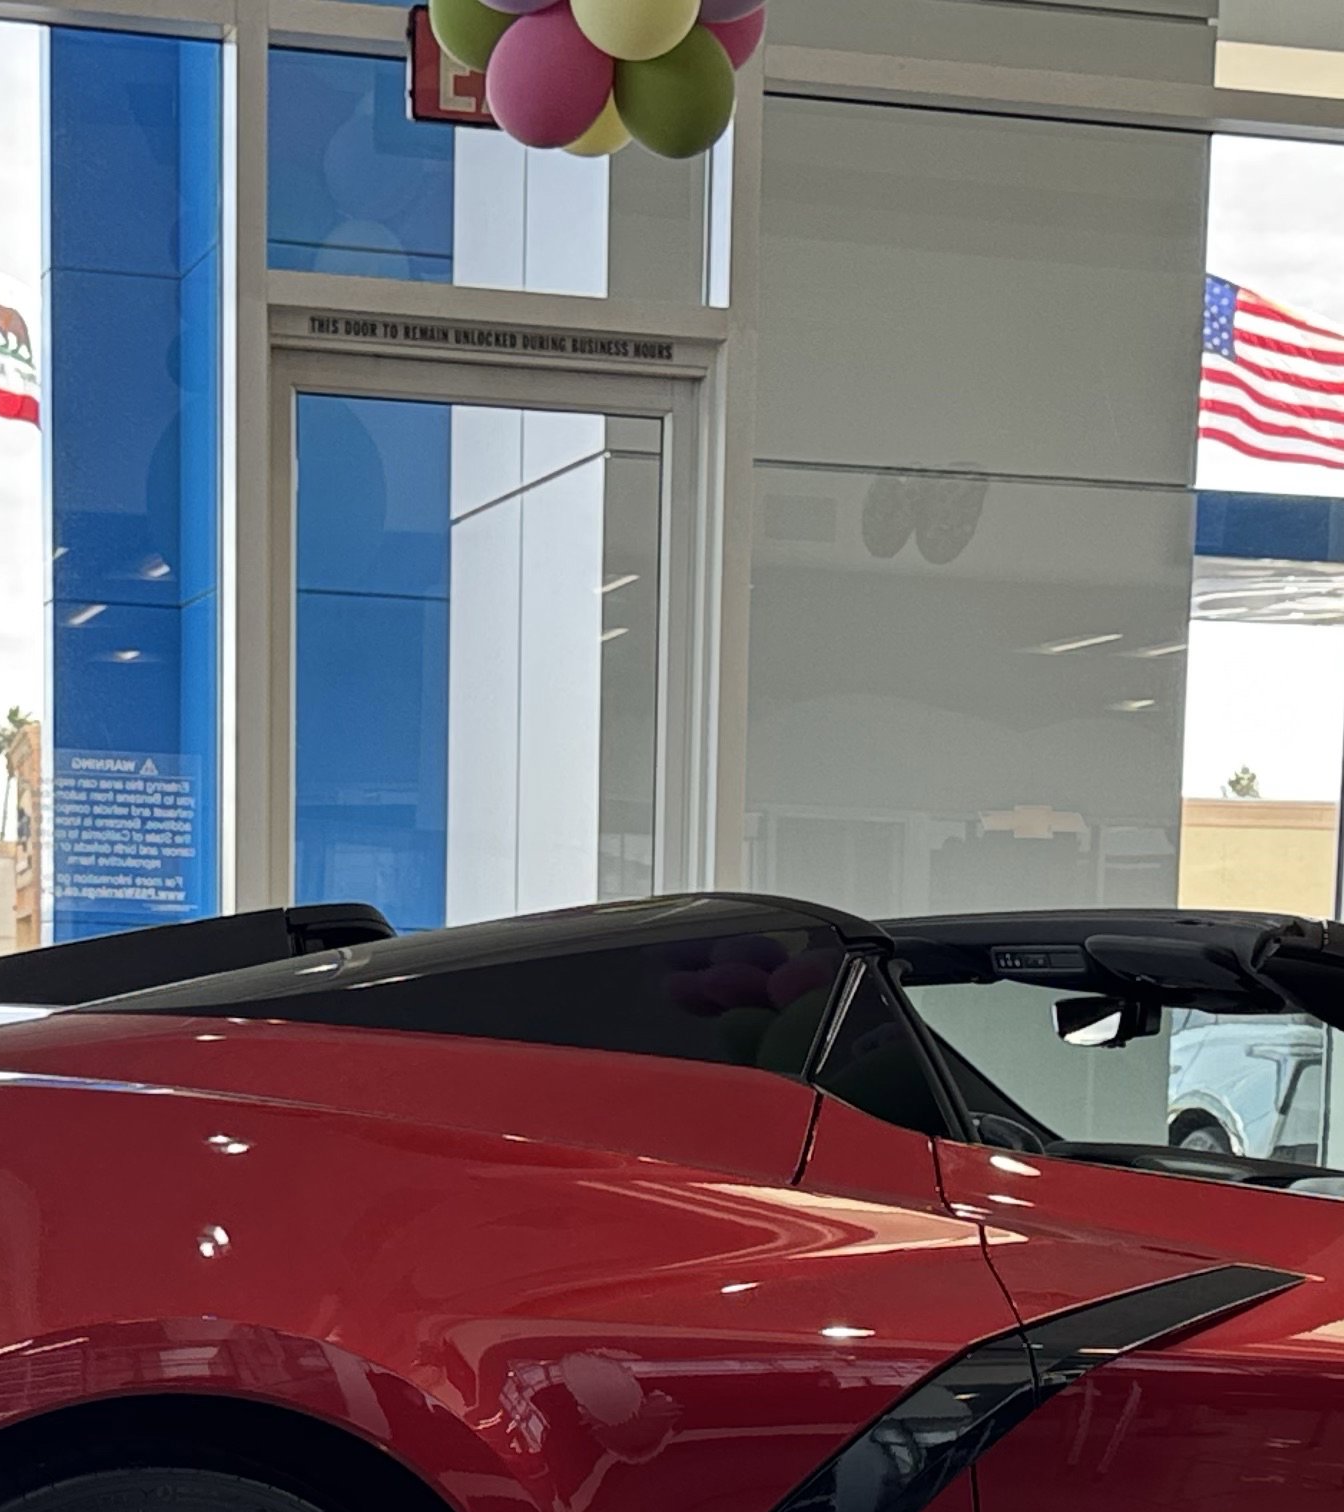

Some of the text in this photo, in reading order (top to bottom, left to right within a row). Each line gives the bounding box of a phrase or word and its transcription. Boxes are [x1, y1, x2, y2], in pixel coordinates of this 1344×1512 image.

[310, 317, 673, 360] THIS DOOR TO REMAIN UNLOCKED DURING BUSINESS HOURS
